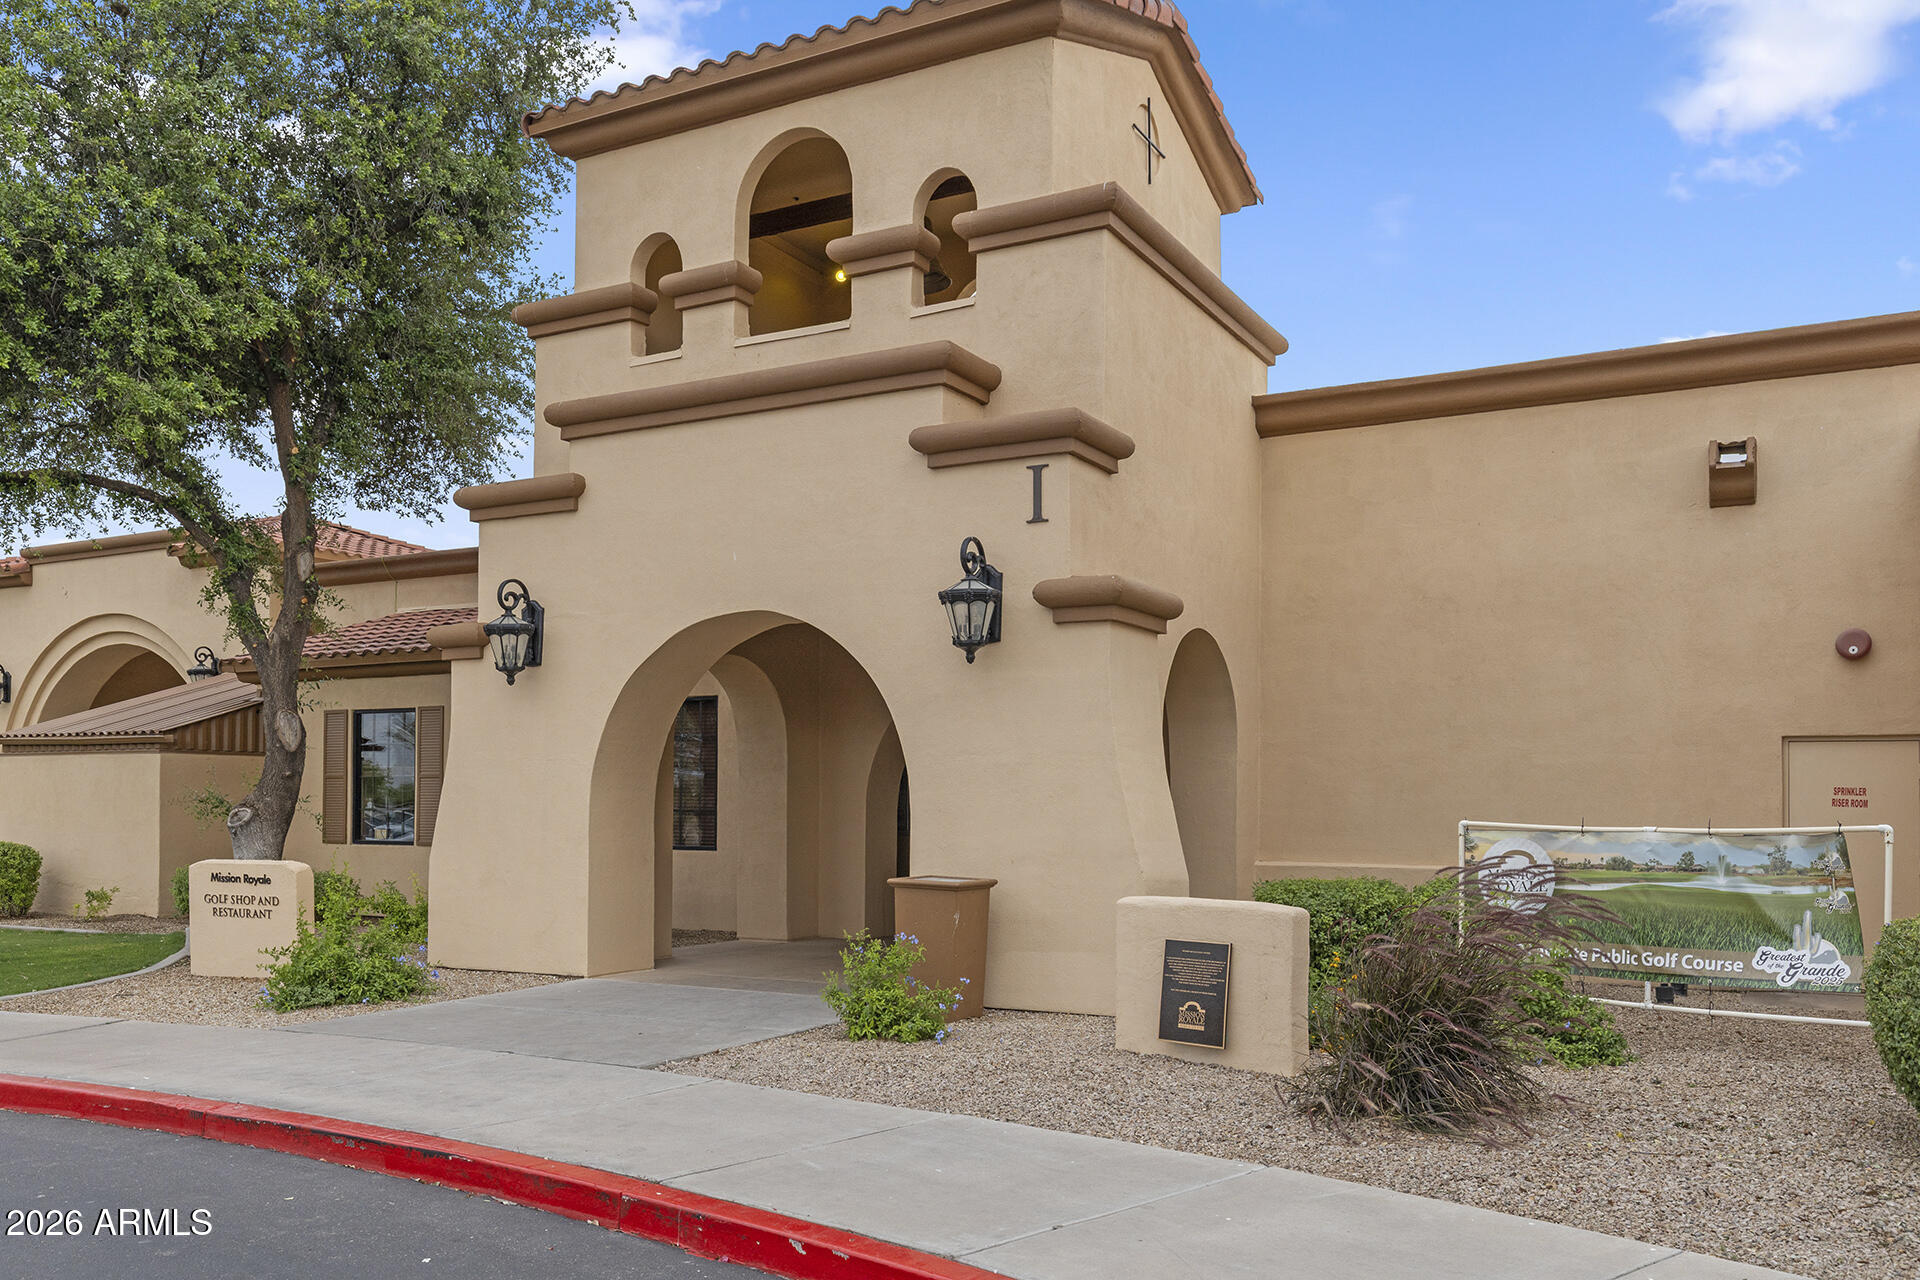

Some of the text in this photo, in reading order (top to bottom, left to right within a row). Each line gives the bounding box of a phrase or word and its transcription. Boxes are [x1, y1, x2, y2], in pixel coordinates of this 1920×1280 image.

[1833, 787, 1867, 796] SPRINKLER
[1832, 798, 1868, 808] RISER ROOM
[210, 872, 271, 886] Mission Royale
[204, 894, 280, 907] GOLF SHOP AND
[212, 907, 273, 919] RESTAURANT
[1591, 947, 1639, 966] Public
[1641, 951, 1679, 968] Golf
[1681, 954, 1744, 972] Course
[1756, 950, 1807, 967] Greatest
[1781, 962, 1846, 984] Grande
[1812, 976, 1844, 986] 2025
